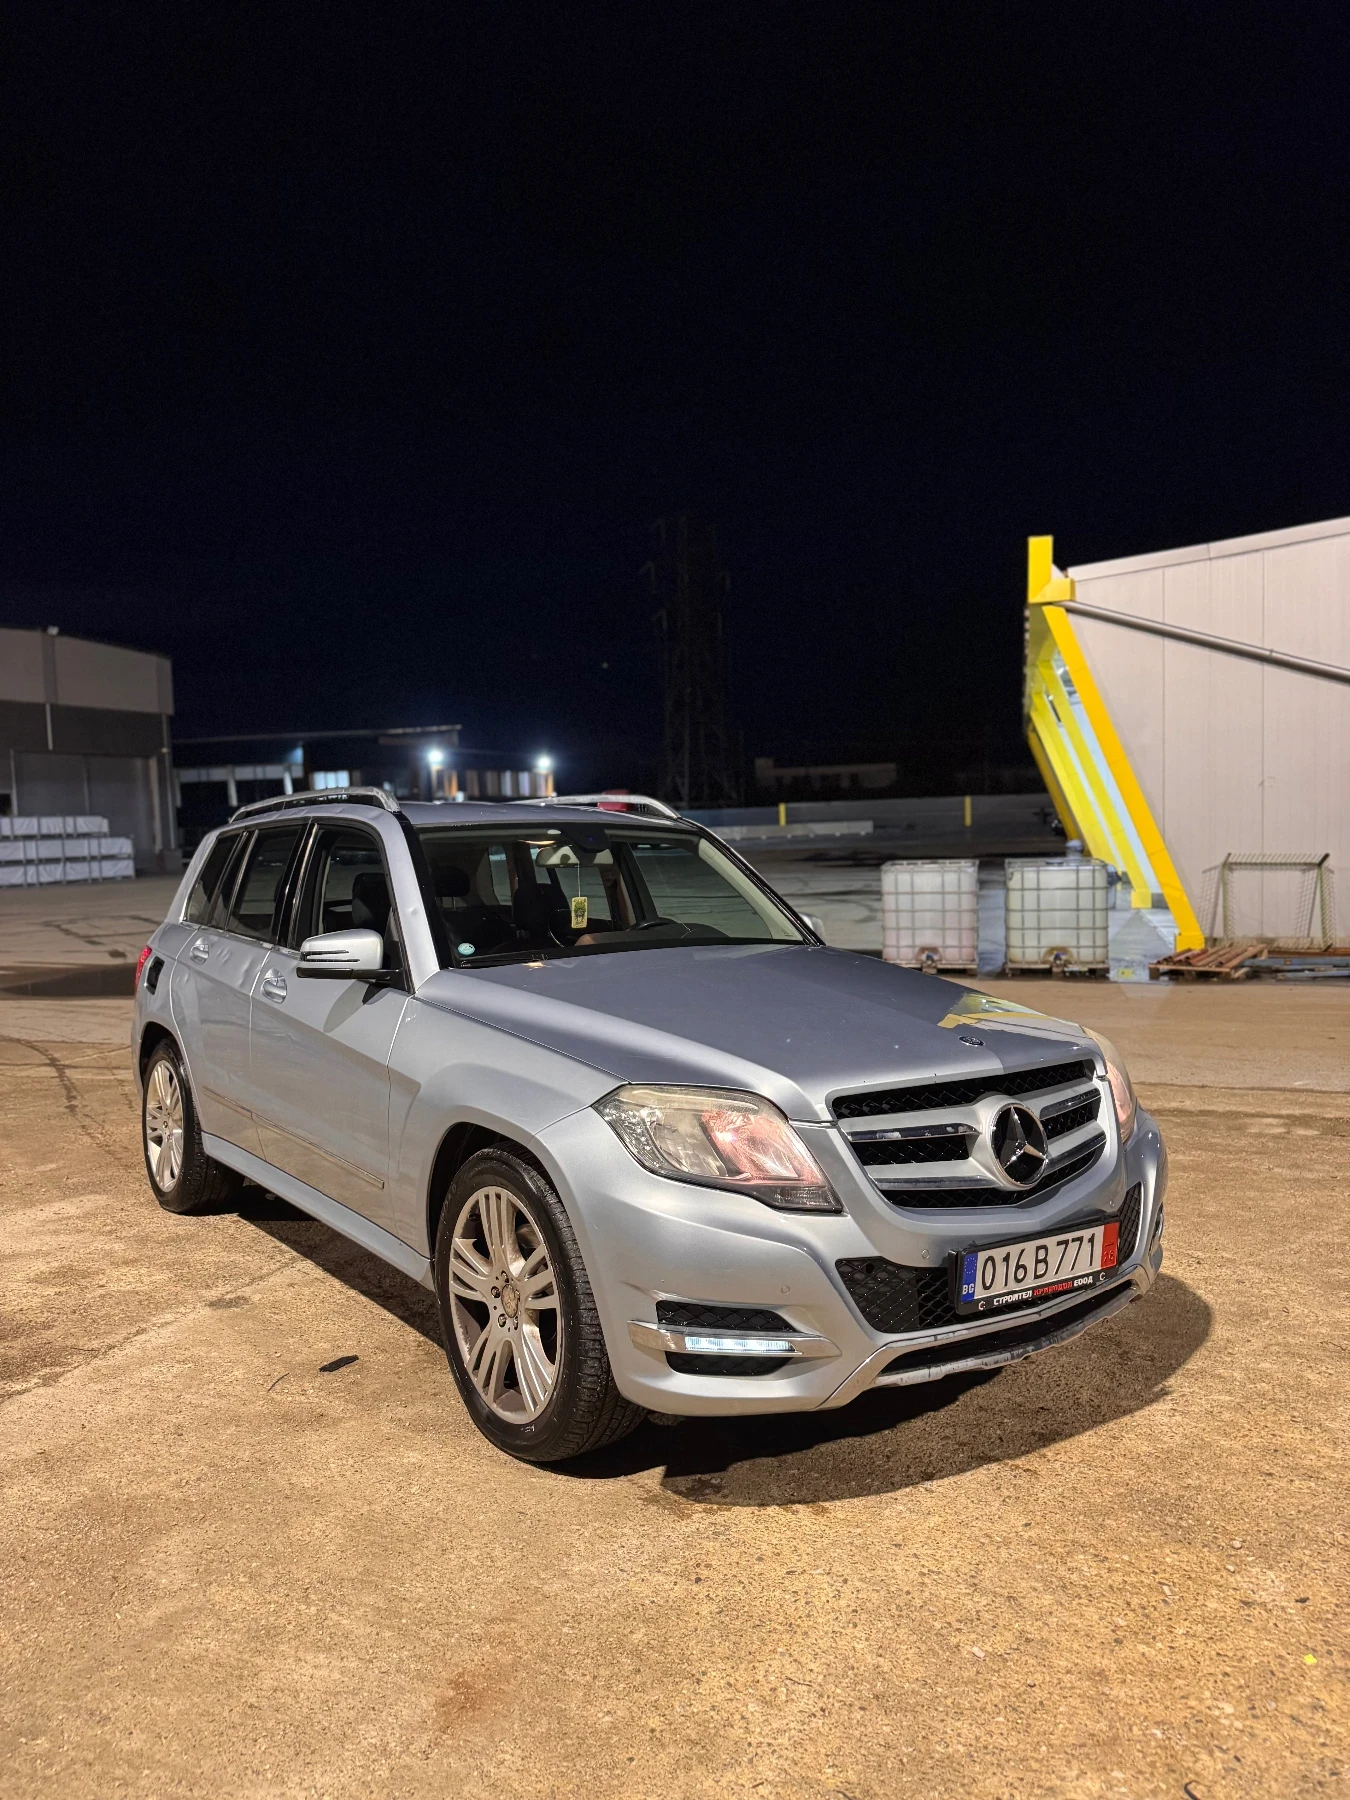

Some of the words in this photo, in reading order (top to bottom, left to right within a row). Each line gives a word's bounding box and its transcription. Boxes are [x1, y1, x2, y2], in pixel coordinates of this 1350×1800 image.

[962, 1283, 975, 1295] BG
[993, 1290, 1033, 1306] СТРОИТЕЛ
[1074, 1275, 1093, 1287] ЕООД
